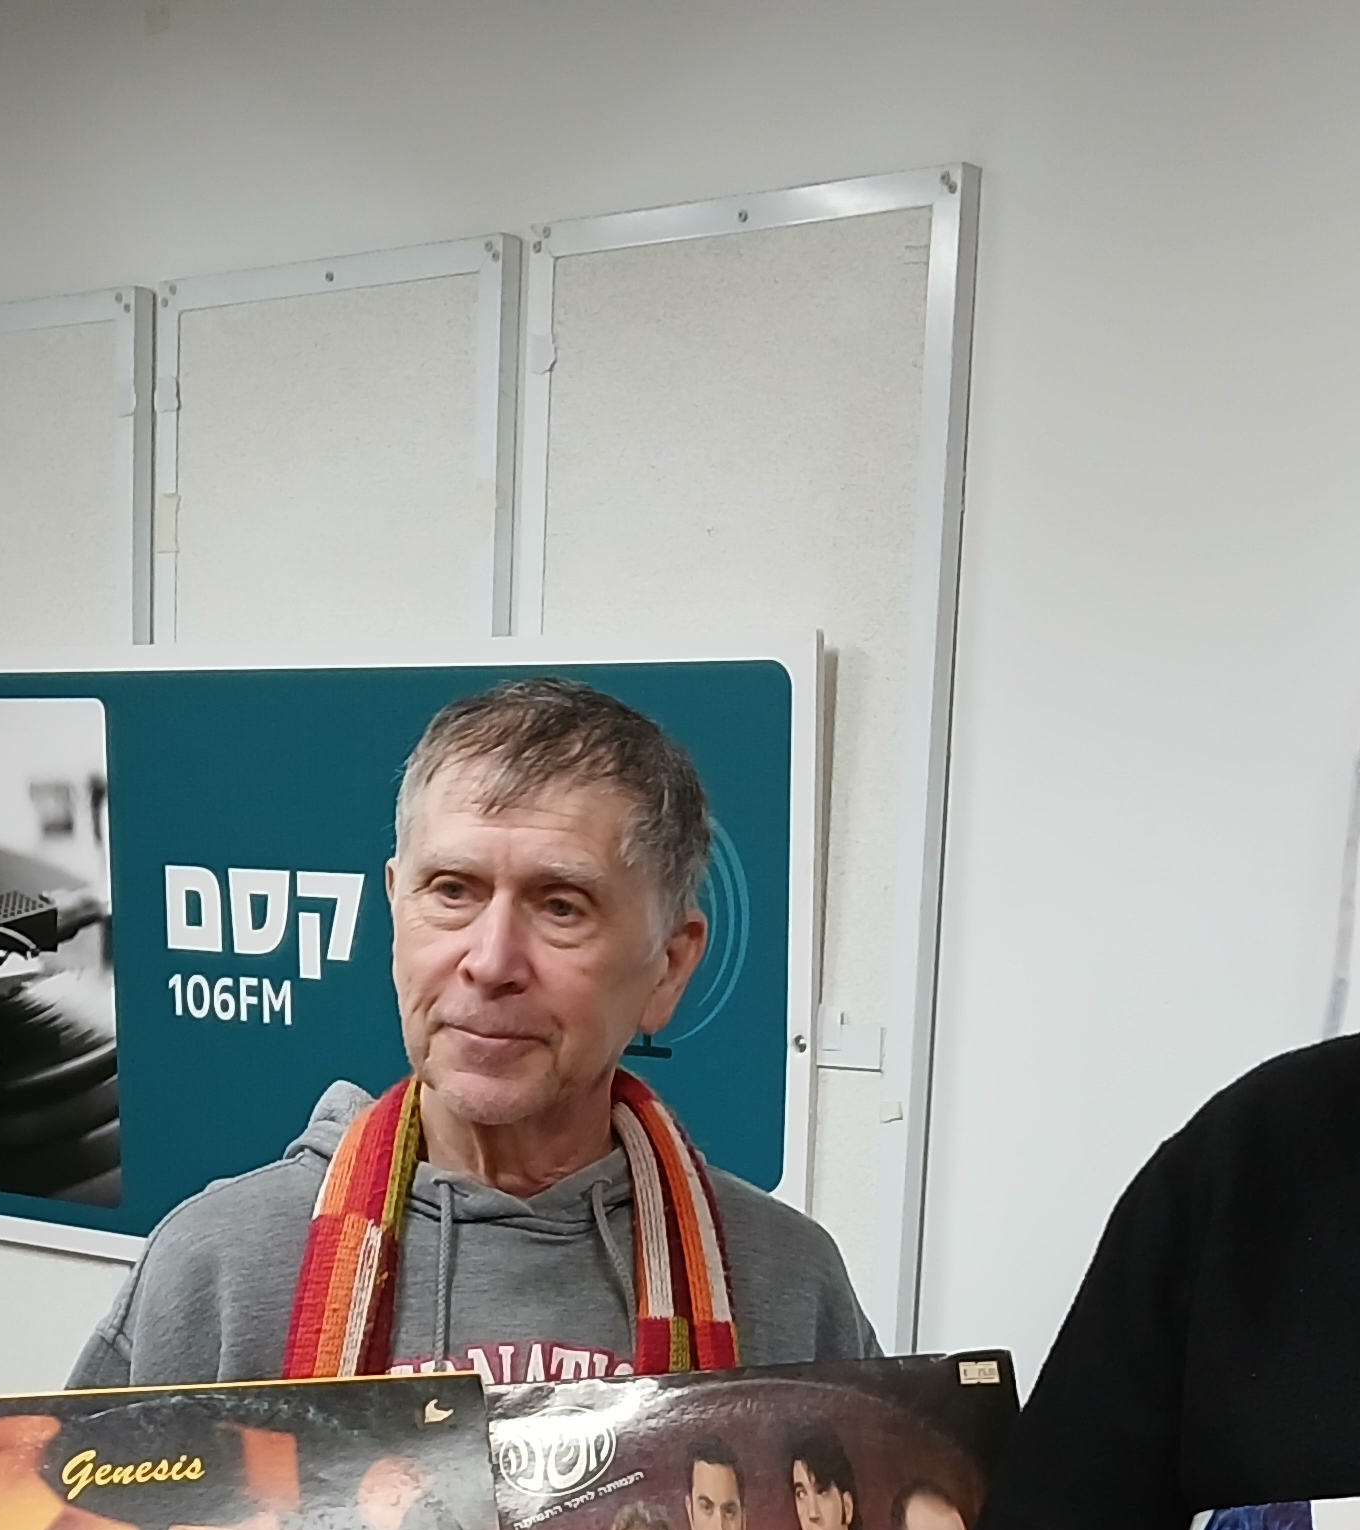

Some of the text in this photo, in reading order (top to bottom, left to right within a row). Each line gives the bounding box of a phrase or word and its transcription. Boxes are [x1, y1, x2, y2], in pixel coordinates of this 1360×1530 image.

[165, 865, 365, 980] קסם
[168, 973, 292, 1025] 106FM
[62, 1450, 205, 1500] Genesis
